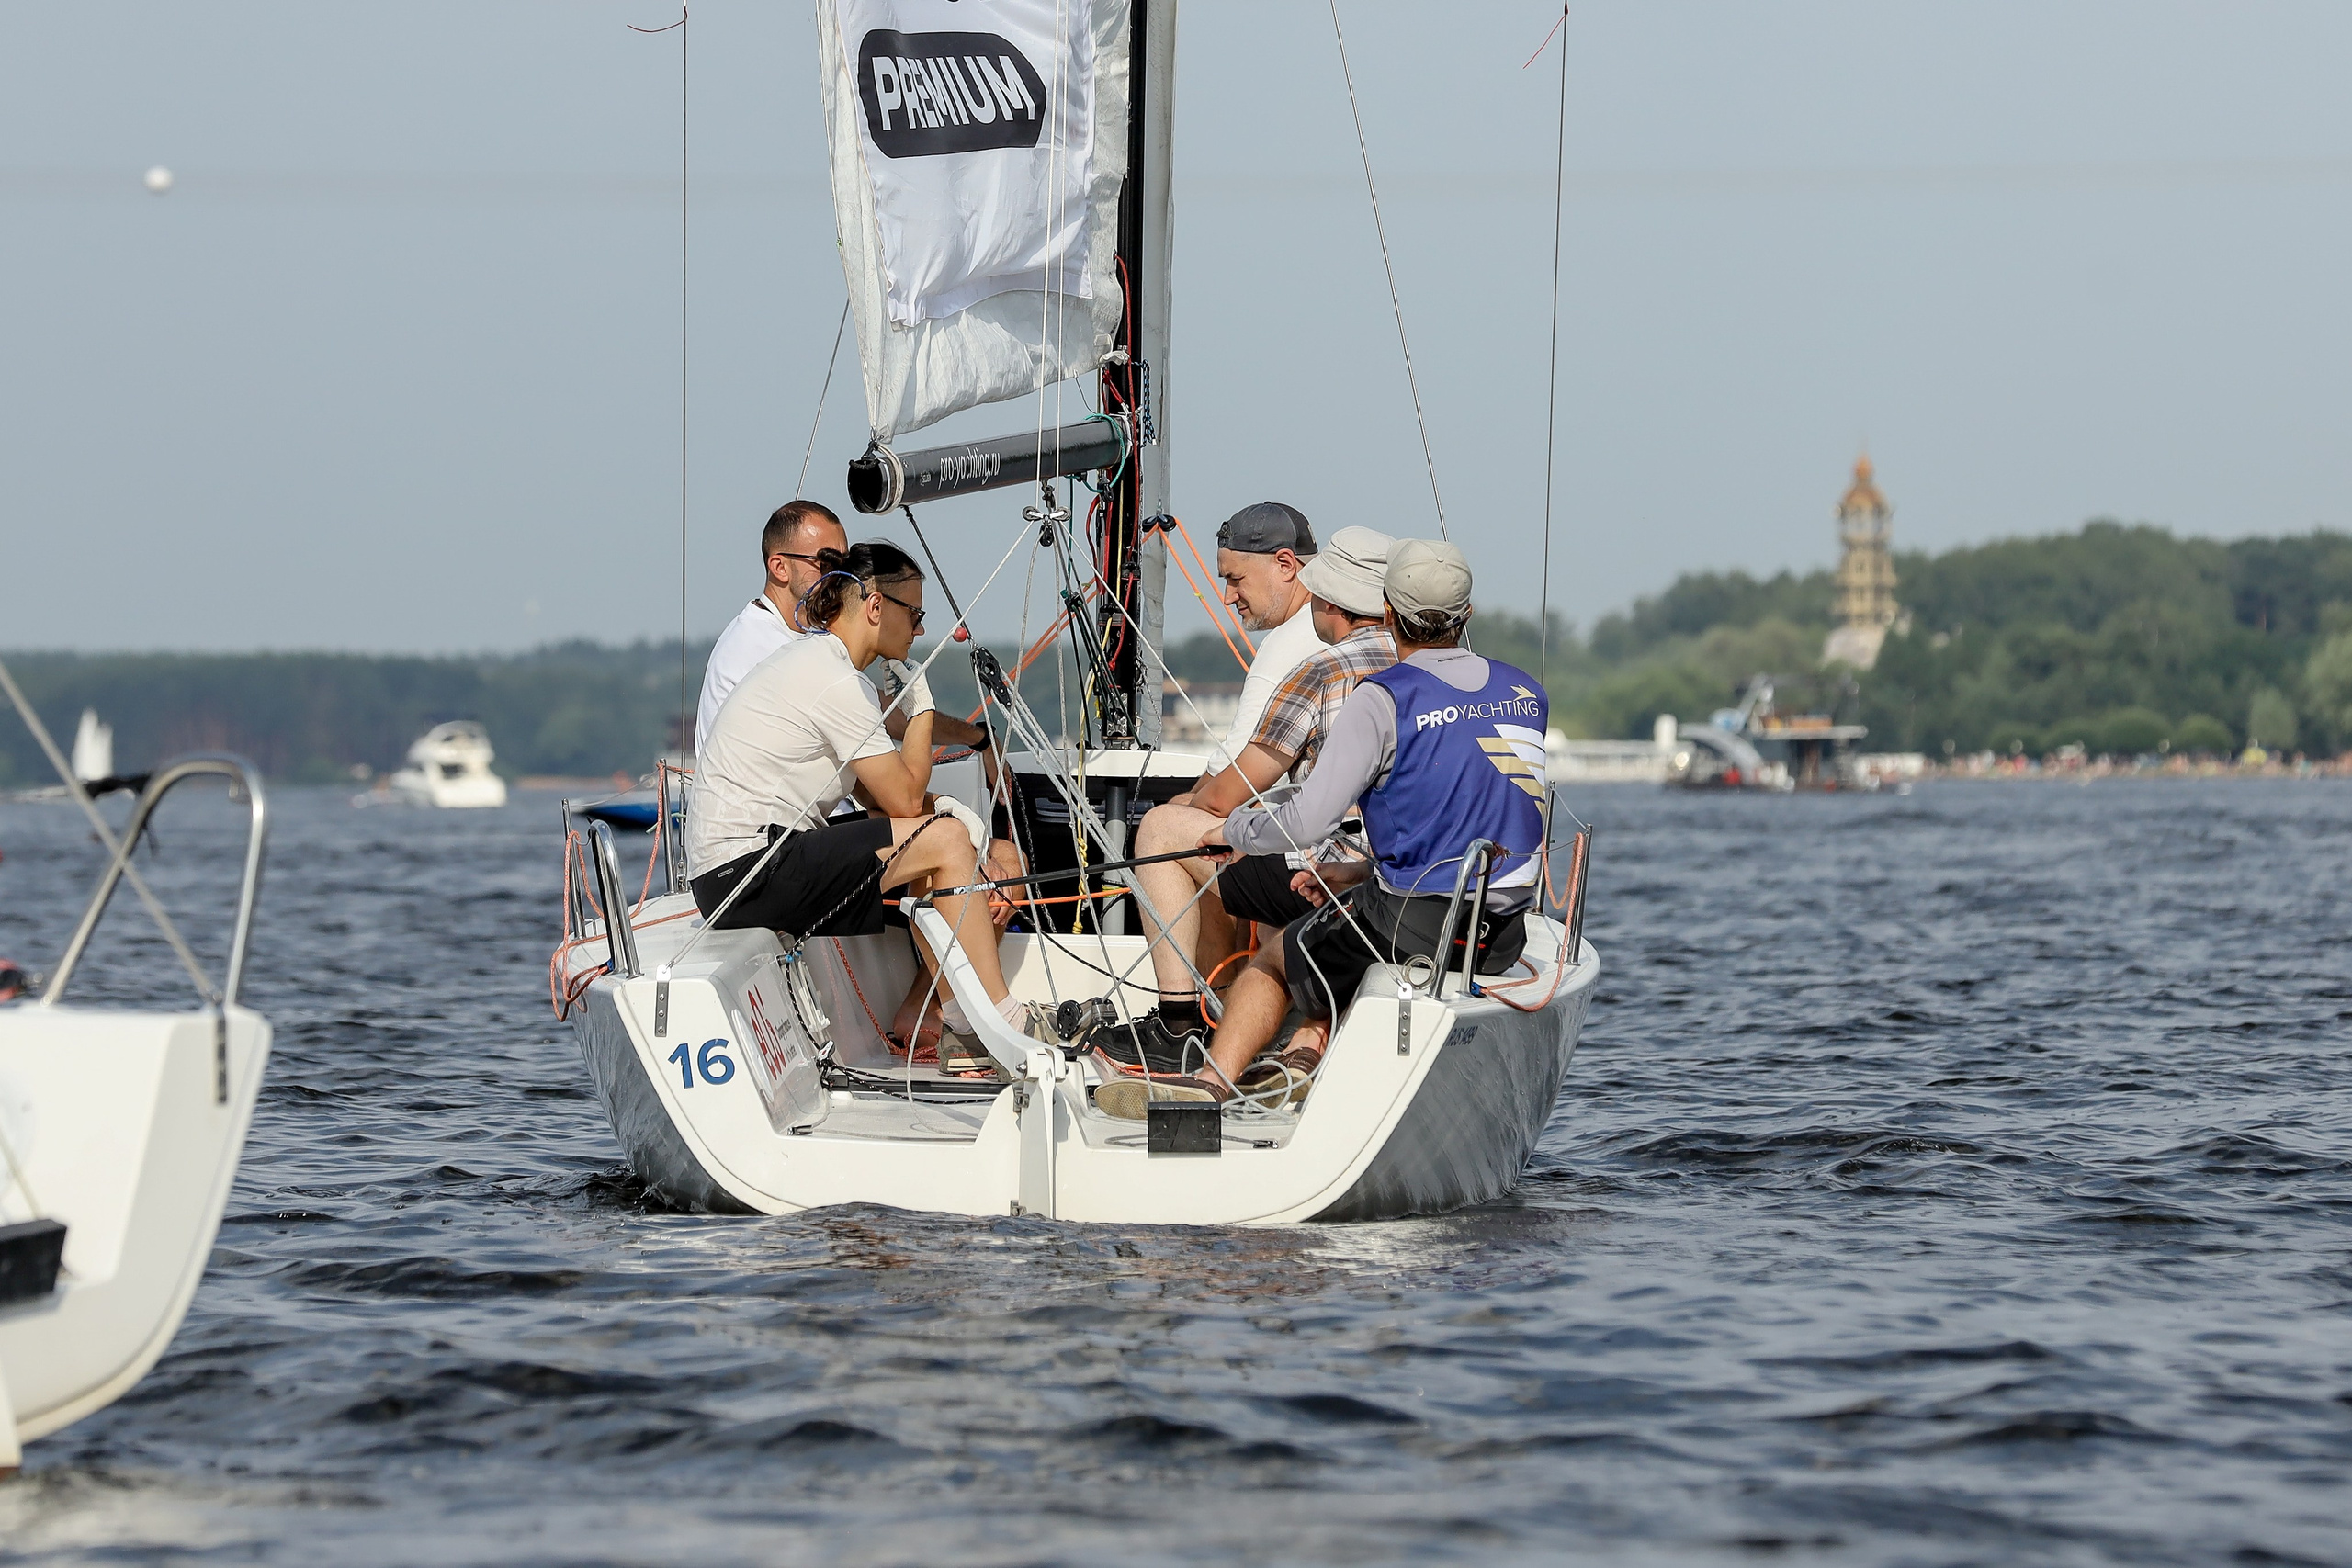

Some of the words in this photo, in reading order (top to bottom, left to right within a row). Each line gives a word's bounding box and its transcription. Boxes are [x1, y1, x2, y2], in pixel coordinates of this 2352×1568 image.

[872, 55, 1035, 130] PREMIUM
[938, 447, 1001, 490] pro-yachting.ru
[1416, 700, 1540, 732] PROYACHTING
[668, 1039, 735, 1089] 16
